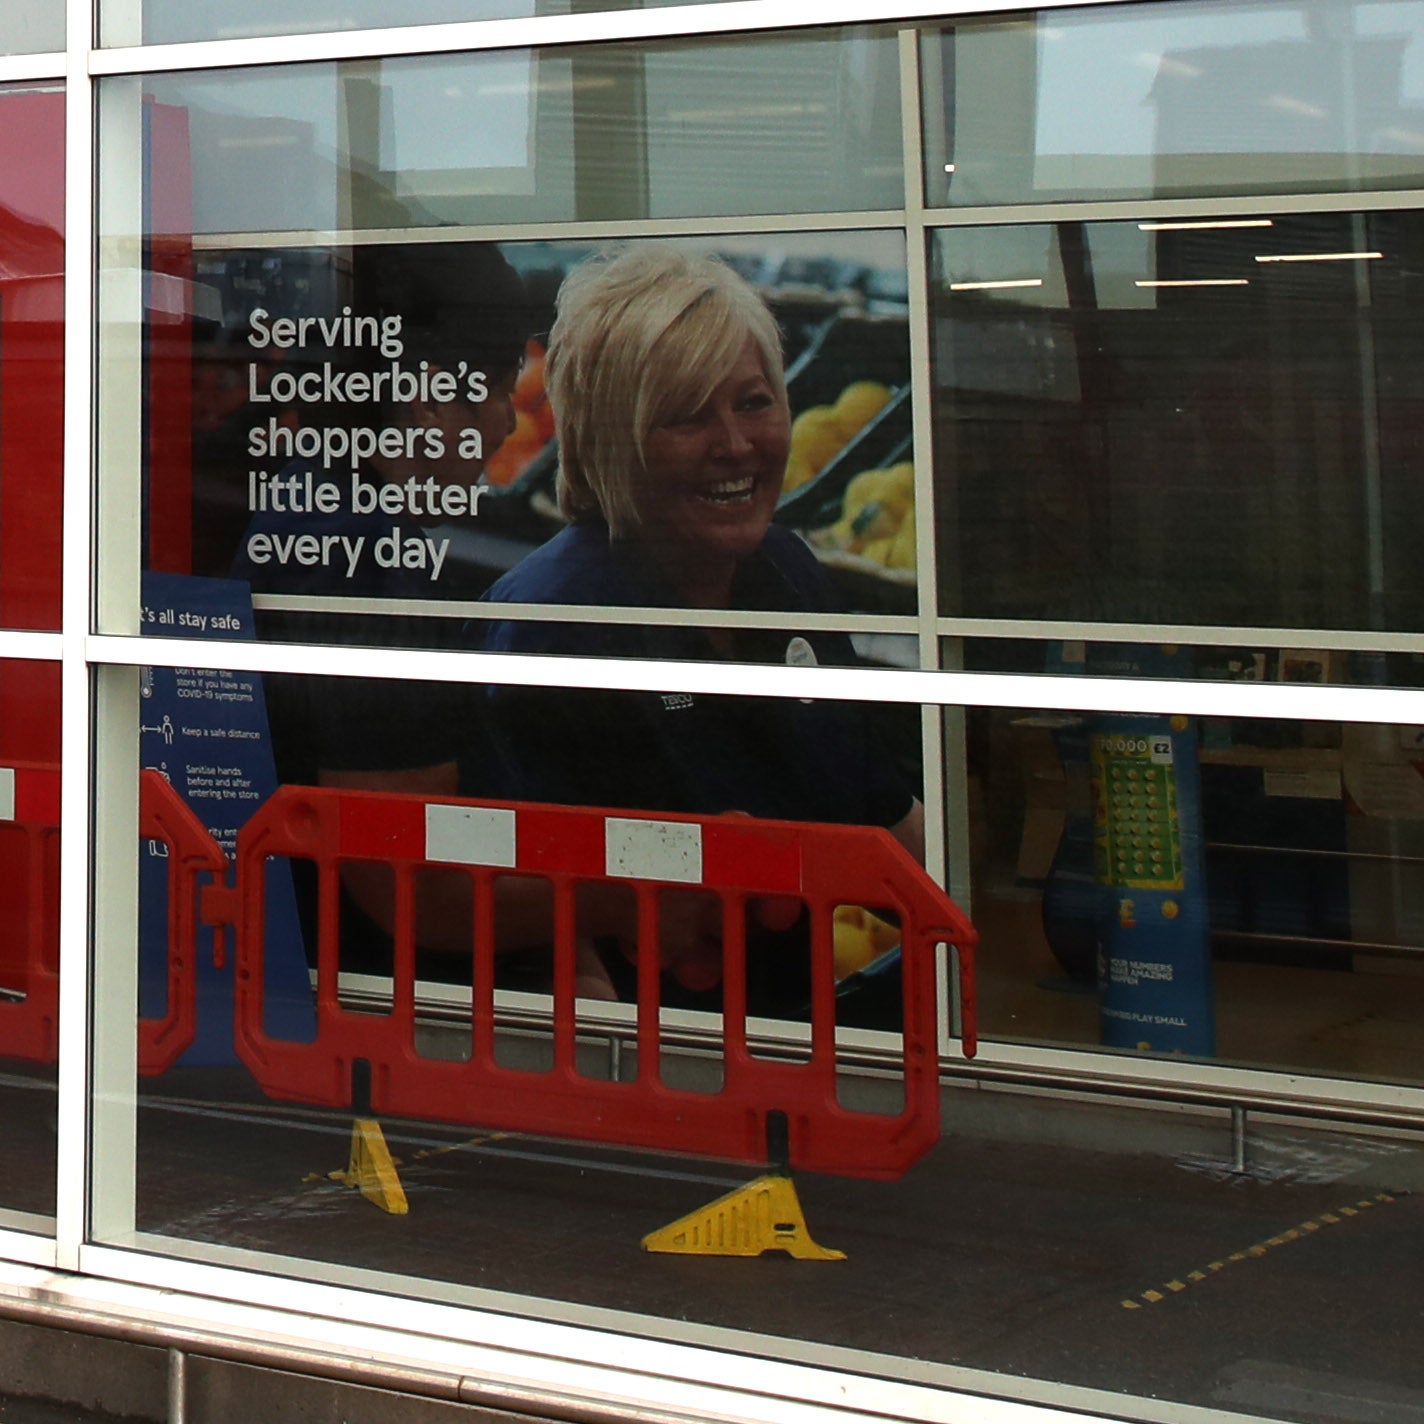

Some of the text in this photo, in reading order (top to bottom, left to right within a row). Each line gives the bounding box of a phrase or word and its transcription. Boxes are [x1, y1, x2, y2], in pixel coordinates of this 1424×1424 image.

[248, 307, 404, 358] Serving
[249, 361, 488, 404] Lockerbie's
[248, 418, 483, 468] shoppers a
[249, 472, 488, 517] little better
[248, 525, 449, 581] every day
[159, 609, 174, 624] all
[179, 612, 207, 631] stay
[211, 614, 240, 629] safe
[177, 678, 197, 687] store
[205, 680, 219, 690] you
[220, 680, 238, 689] have
[239, 682, 252, 692] any
[177, 689, 253, 702] COVID-19 symptoms
[181, 726, 202, 737] Keep
[210, 728, 226, 737] safe
[228, 729, 261, 739] distance
[1153, 742, 1170, 754] £2
[186, 765, 242, 776] Sanitise hands
[187, 777, 251, 787] before and after
[188, 790, 259, 800] entering the store
[208, 827, 237, 837] rity ent
